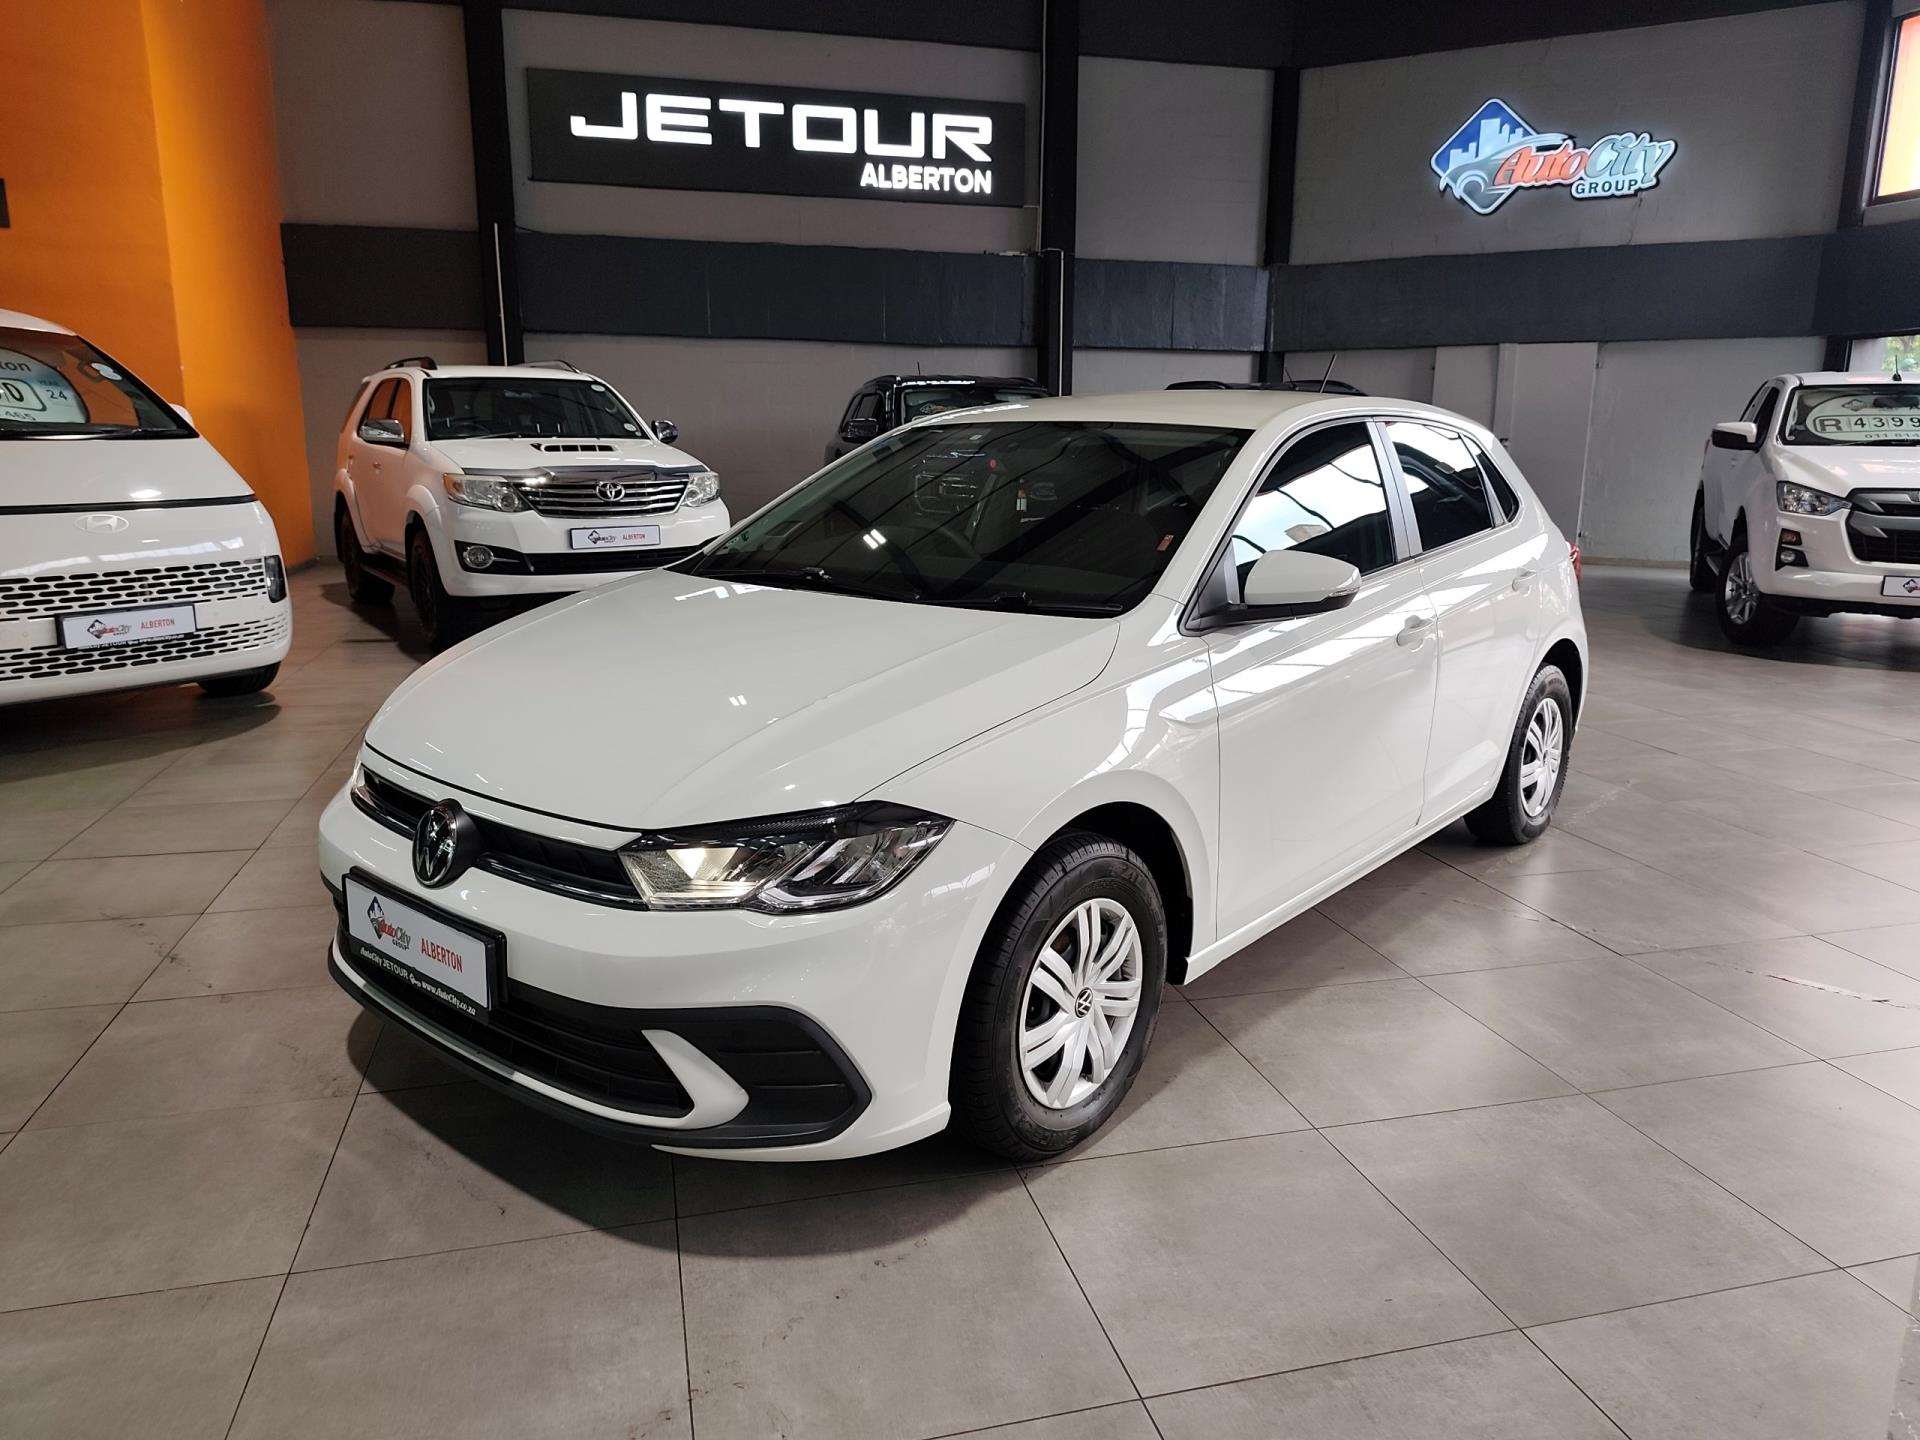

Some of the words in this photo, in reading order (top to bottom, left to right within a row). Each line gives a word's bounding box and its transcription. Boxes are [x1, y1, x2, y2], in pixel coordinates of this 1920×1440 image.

[570, 91, 993, 162] JETOUR
[860, 162, 992, 194] ALBERTON
[1574, 178, 1639, 195] GROUP
[140, 618, 175, 630] ALBERTON
[383, 958, 409, 980] JETOUR
[420, 937, 464, 974] ALBERTON
